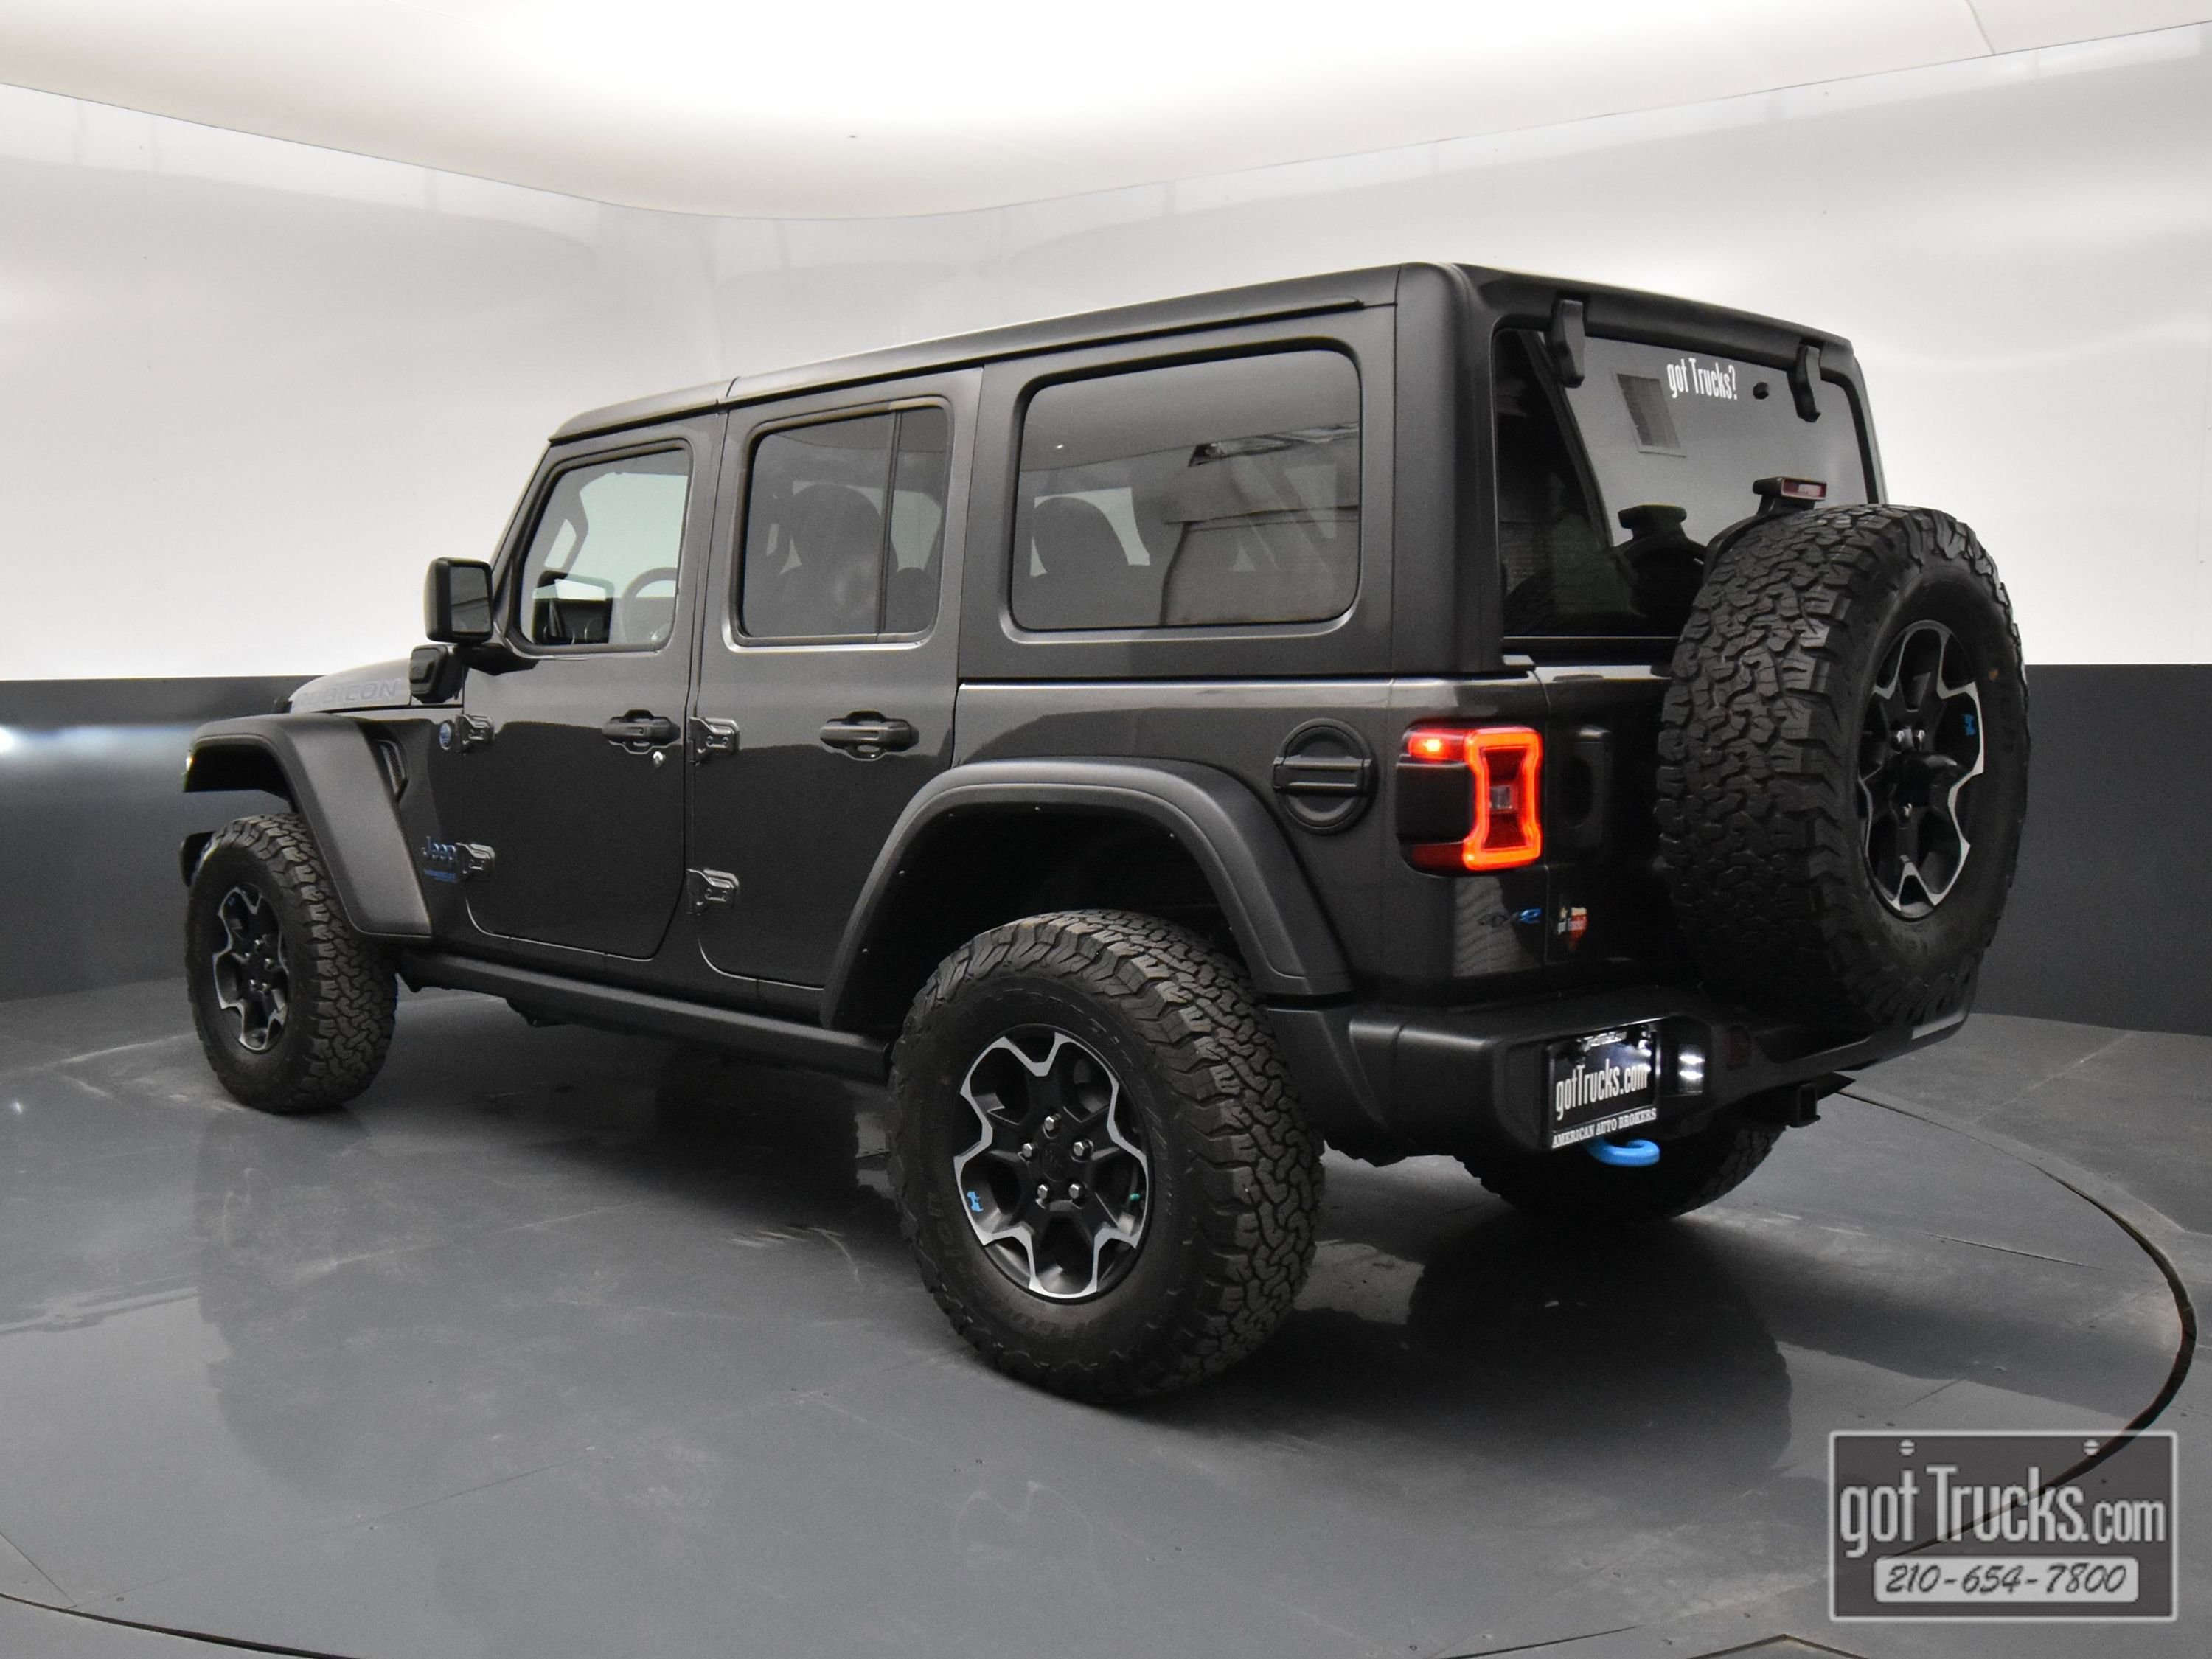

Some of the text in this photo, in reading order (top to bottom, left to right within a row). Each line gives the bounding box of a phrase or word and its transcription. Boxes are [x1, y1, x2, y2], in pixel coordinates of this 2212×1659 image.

[1667, 358, 1737, 400] got Trucks?
[1556, 1058, 1649, 1121] gotTrucks.com
[1553, 1109, 1657, 1147] AMERICAN AUTO BROKERS
